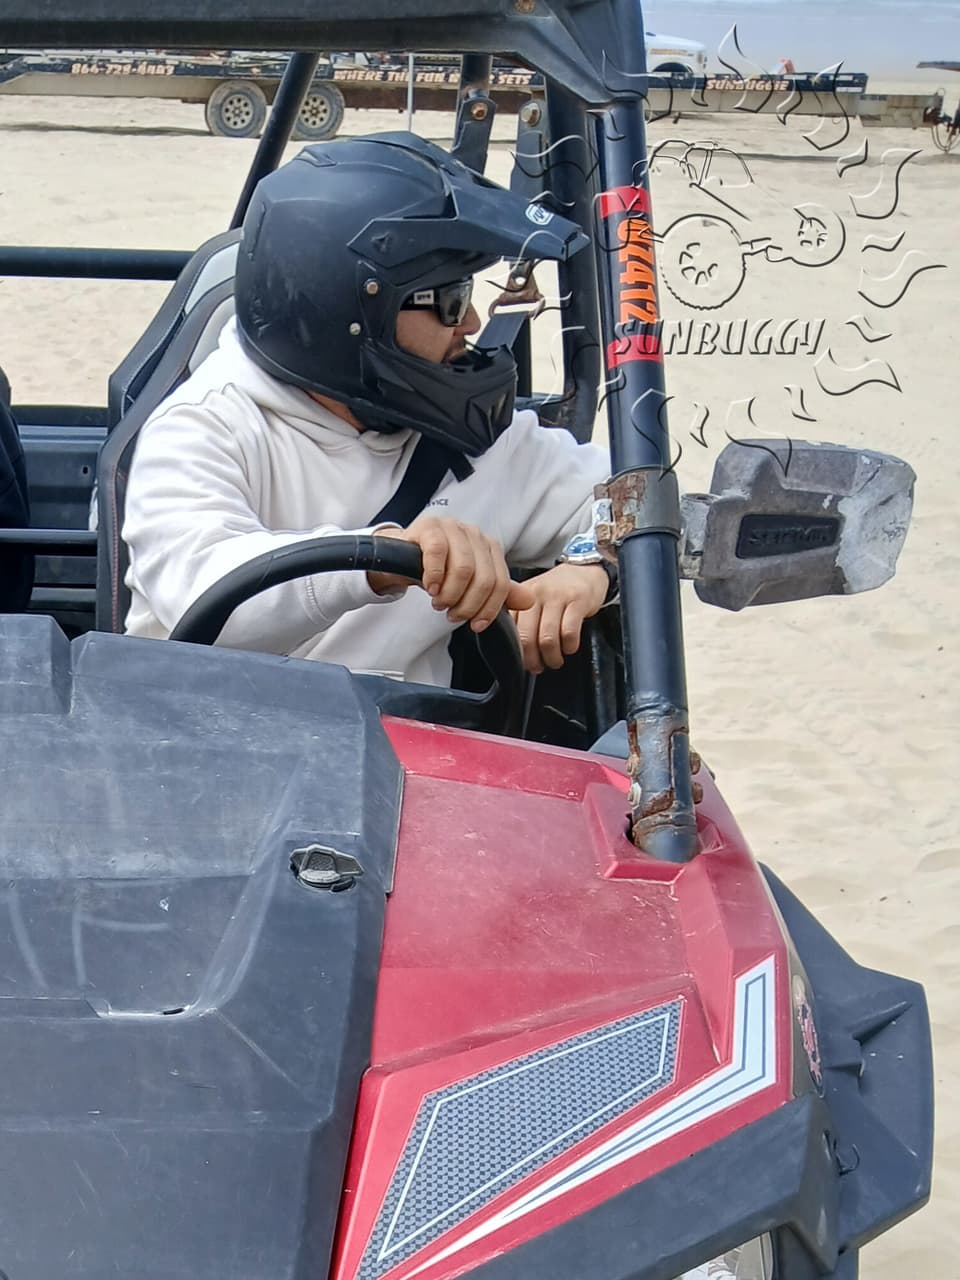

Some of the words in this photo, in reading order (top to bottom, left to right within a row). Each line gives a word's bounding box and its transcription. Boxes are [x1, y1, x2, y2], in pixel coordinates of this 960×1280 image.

[333, 69, 384, 81] WHERE
[416, 72, 445, 83] FUN
[497, 73, 533, 85] SETS
